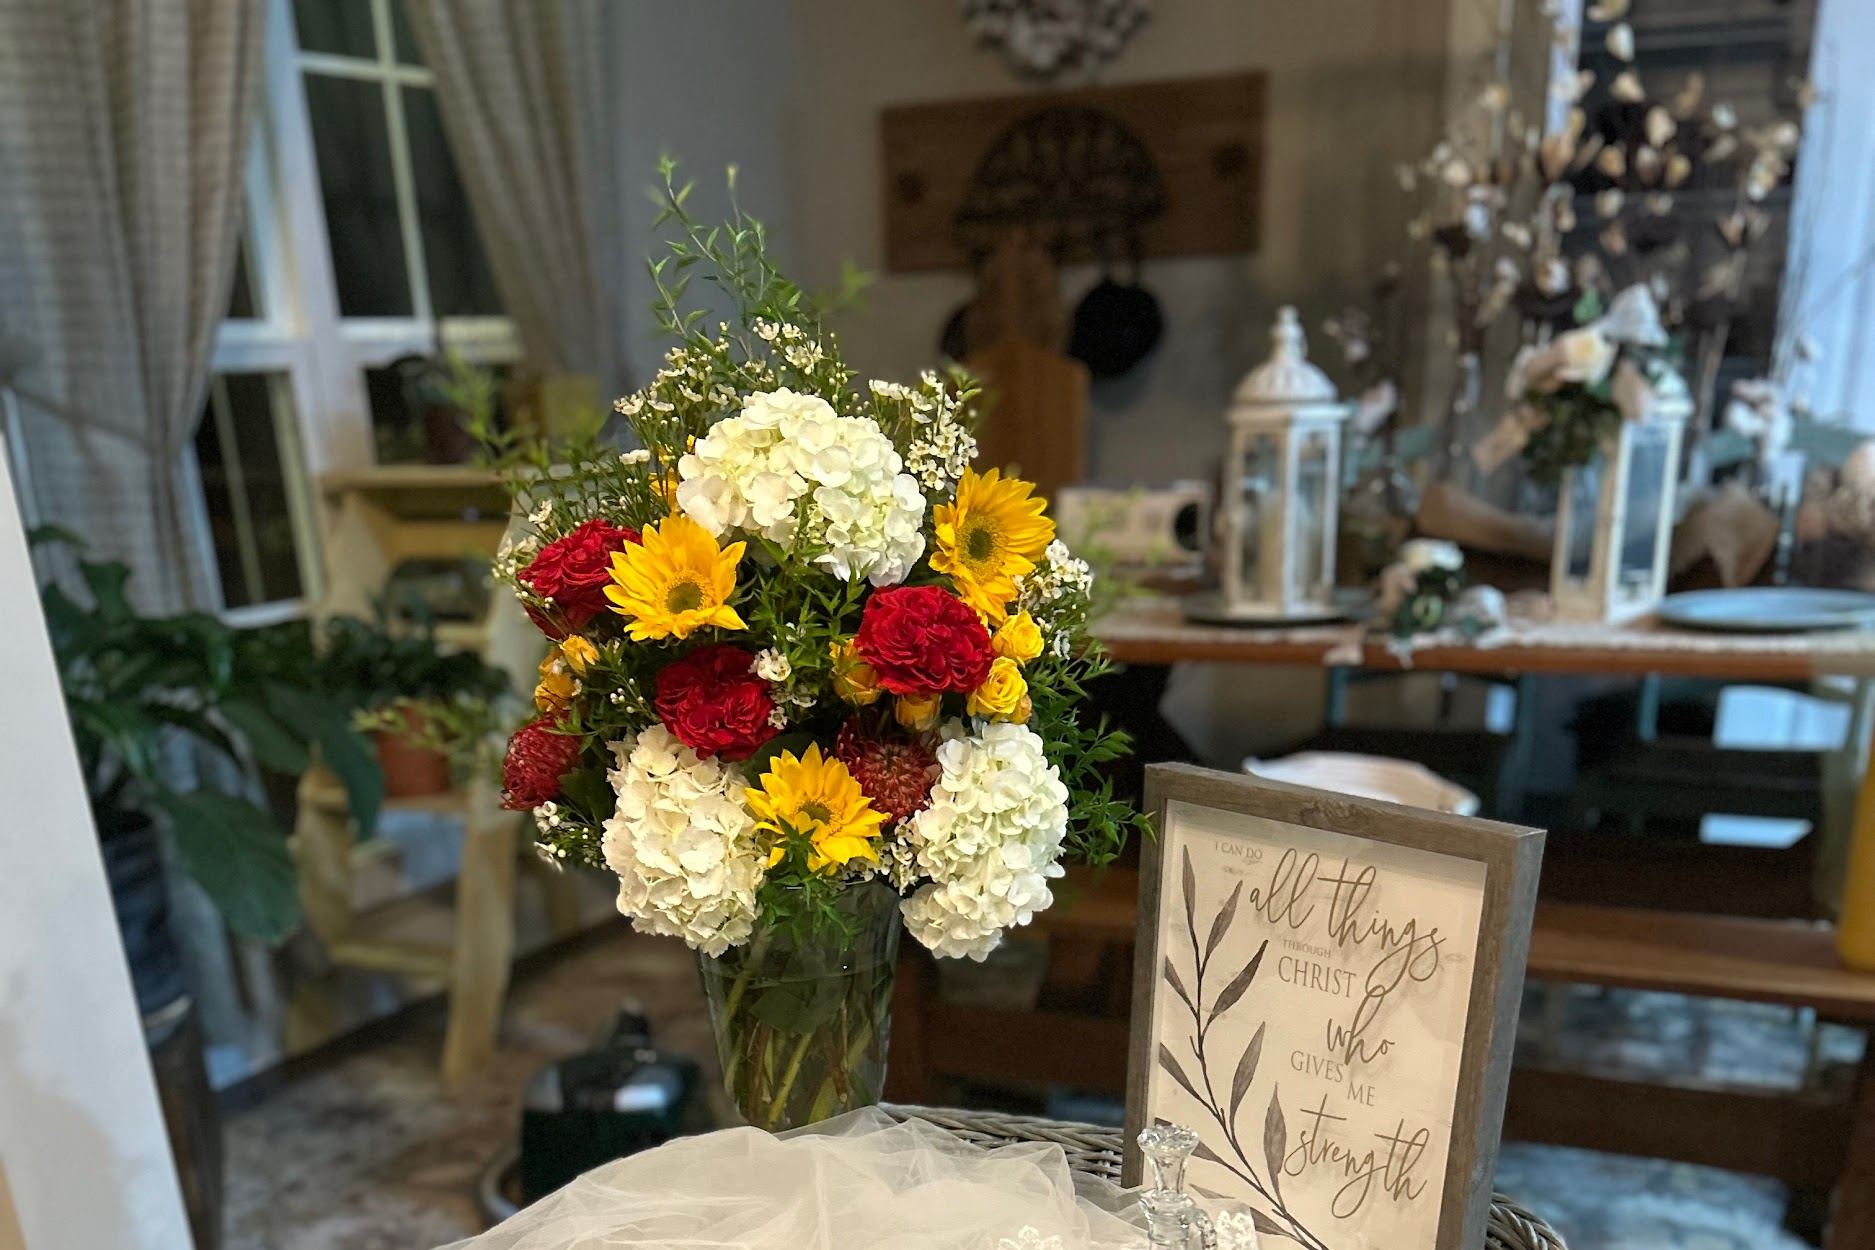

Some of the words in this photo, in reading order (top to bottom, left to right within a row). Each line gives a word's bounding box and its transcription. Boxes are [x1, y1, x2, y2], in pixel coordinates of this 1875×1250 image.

[1221, 842, 1243, 857] CAN
[1246, 846, 1263, 860] DO
[1249, 848, 1320, 930] all
[1317, 857, 1448, 998] things
[1282, 938, 1333, 959] THROUGH
[1278, 955, 1358, 999] CHRIST
[1326, 984, 1396, 1066] who
[1290, 1050, 1345, 1084] GIVES
[1347, 1081, 1376, 1107] ME
[1283, 1093, 1430, 1220] strength
